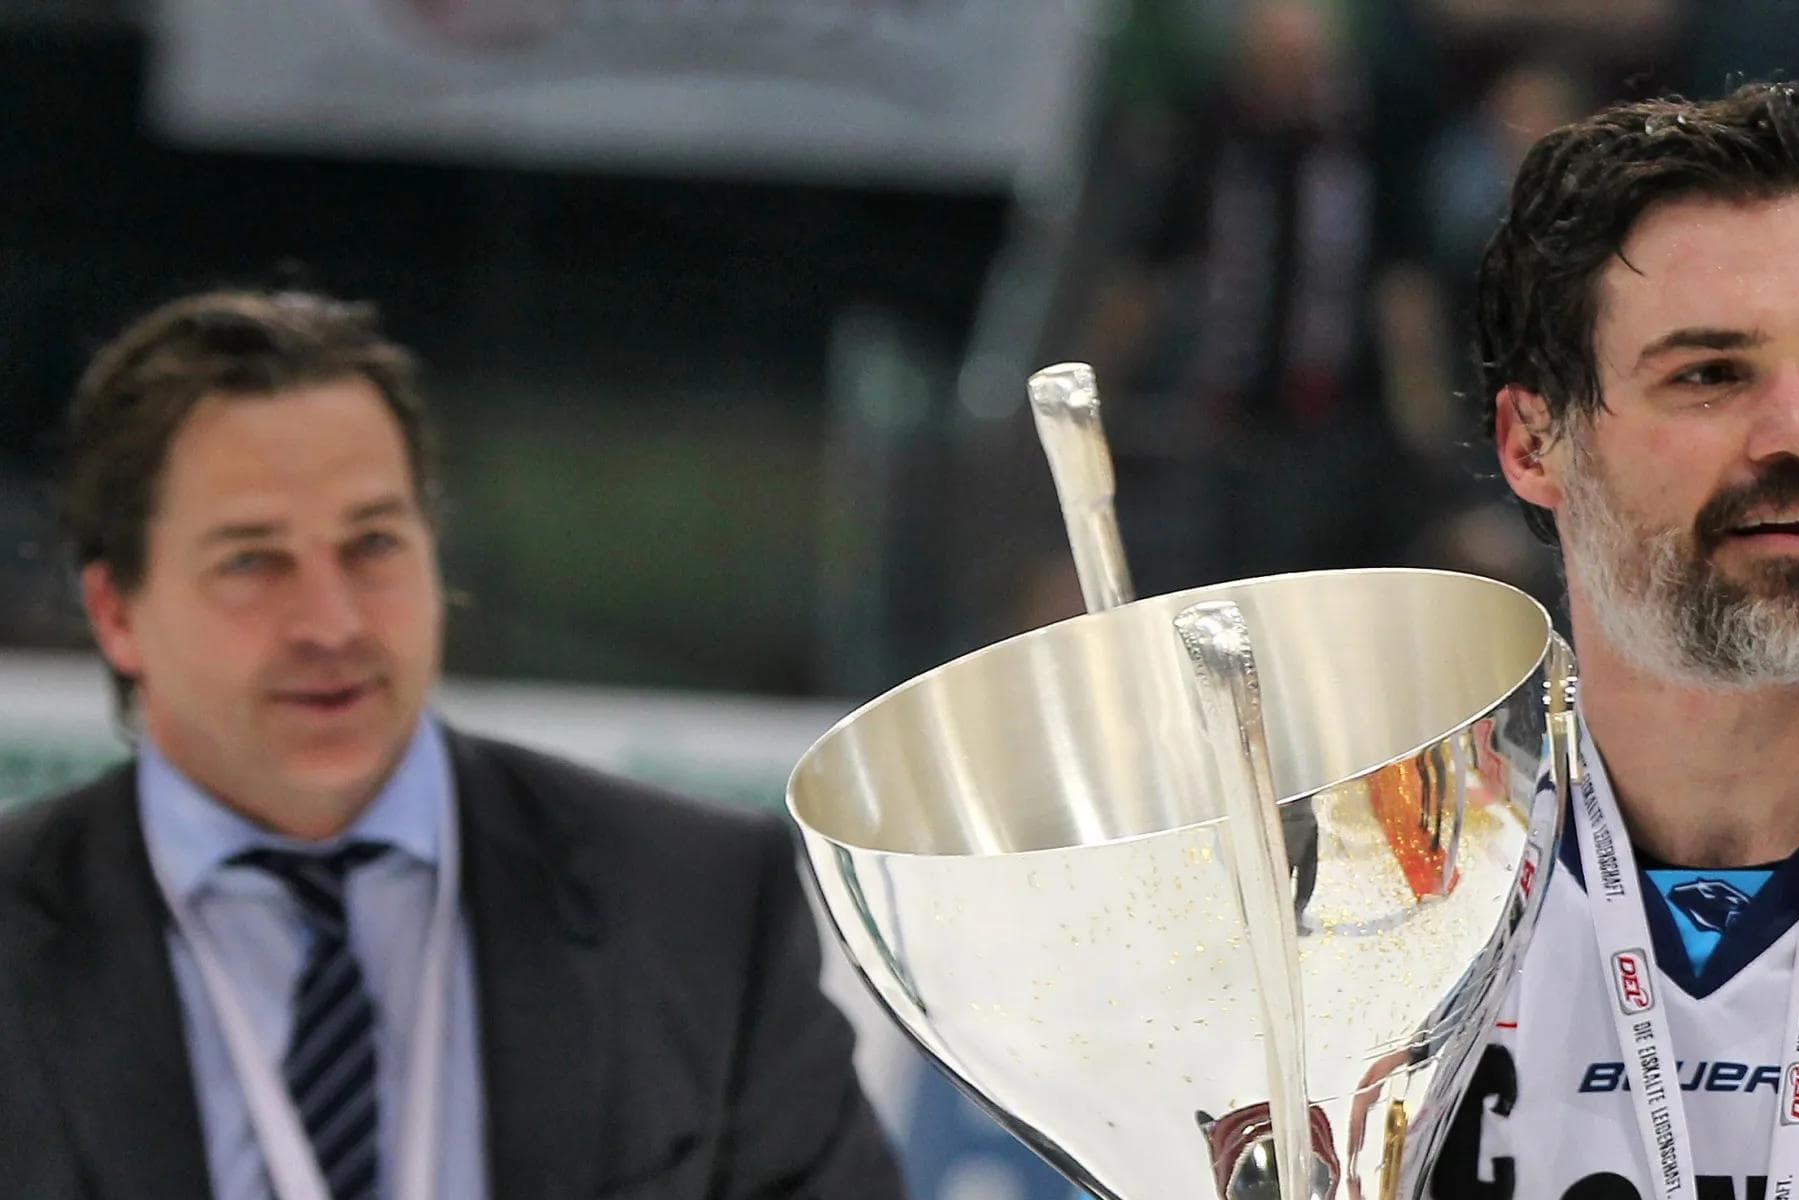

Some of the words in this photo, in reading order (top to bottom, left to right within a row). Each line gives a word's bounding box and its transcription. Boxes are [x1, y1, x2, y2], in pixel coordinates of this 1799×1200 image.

[1593, 821, 1625, 903] LEIDENSCHAFT.
[1632, 1019, 1654, 1043] DIE
[1637, 1046, 1666, 1104] EISKALTE
[1651, 1105, 1681, 1200] LEIDENSCHAFT.
